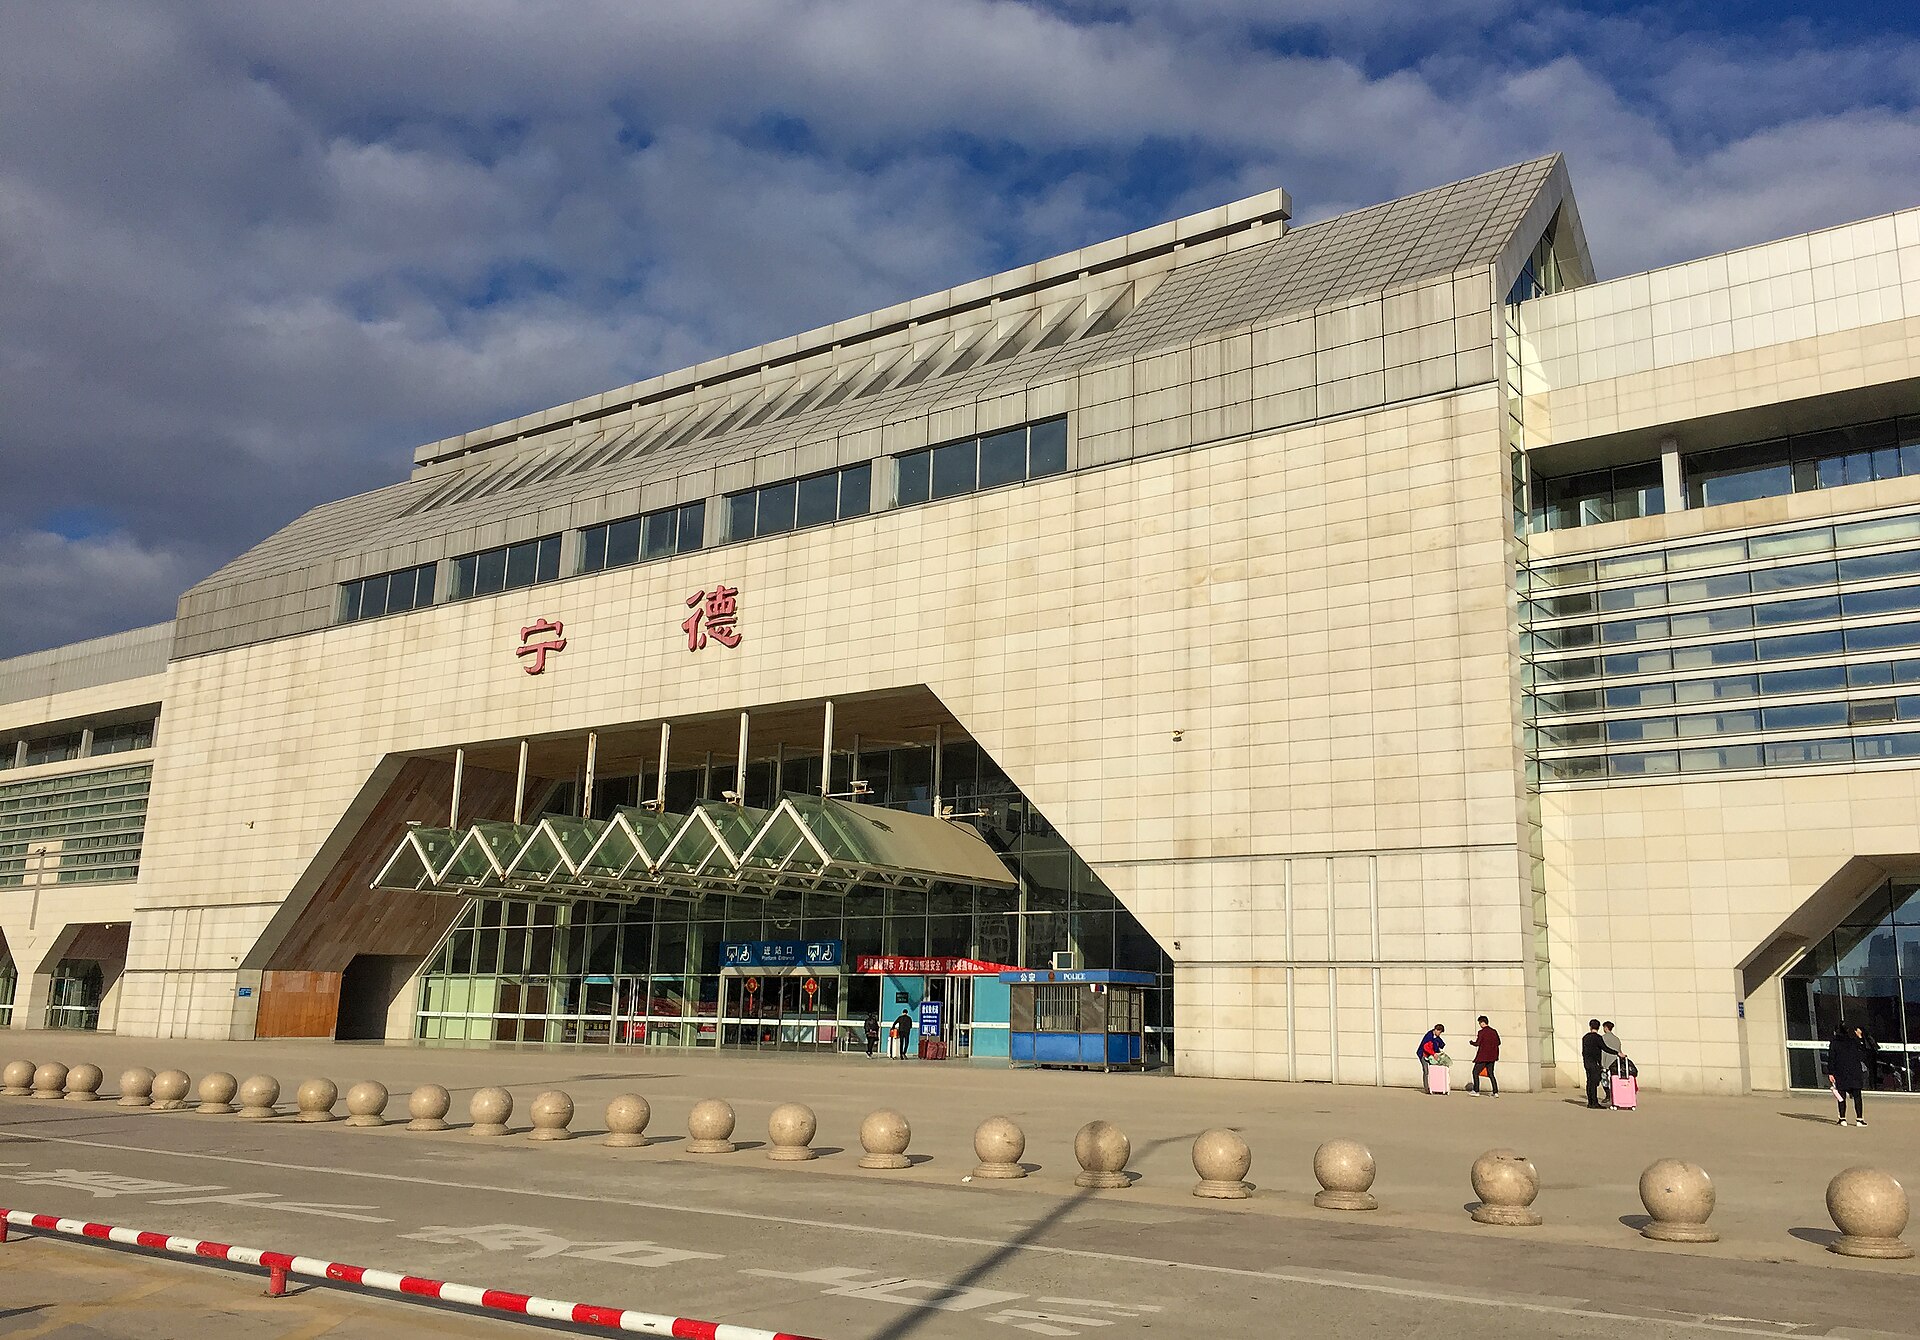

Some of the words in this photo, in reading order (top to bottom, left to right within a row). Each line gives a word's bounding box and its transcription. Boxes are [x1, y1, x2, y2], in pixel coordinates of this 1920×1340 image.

[516, 585, 742, 675] 宁德
[763, 946, 793, 955] 进站口
[1020, 973, 1036, 982] 公安
